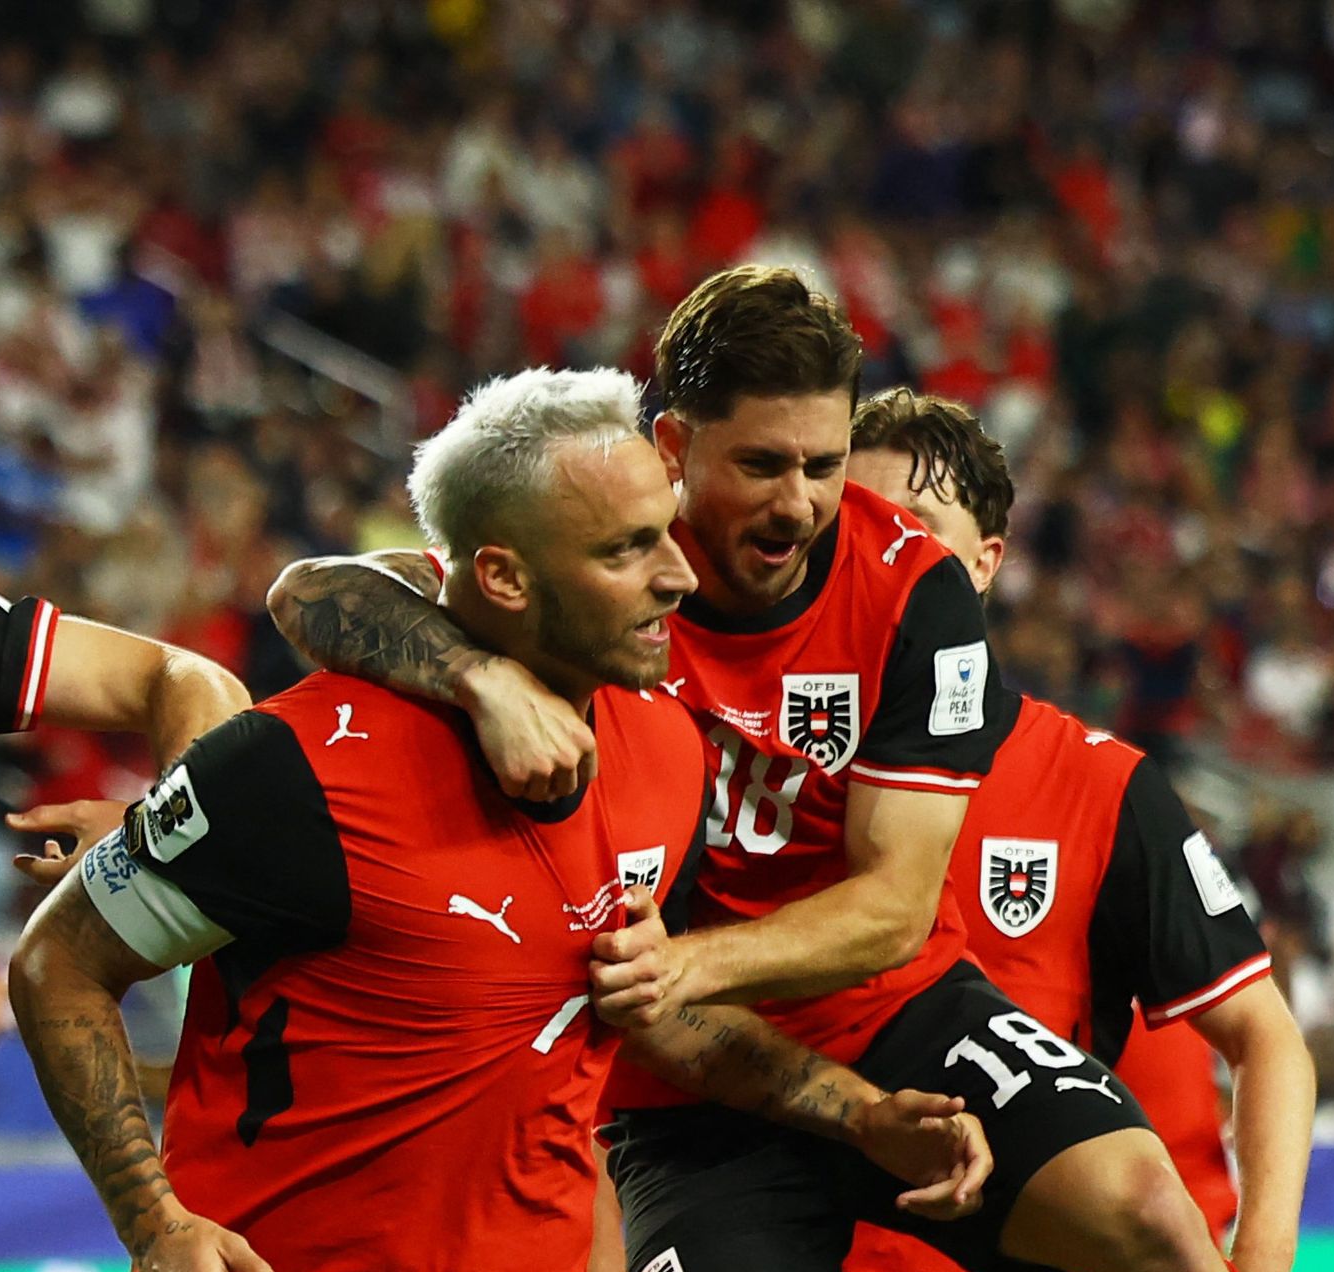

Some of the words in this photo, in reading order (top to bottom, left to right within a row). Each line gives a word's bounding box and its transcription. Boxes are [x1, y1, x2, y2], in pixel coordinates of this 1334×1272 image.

[802, 681, 835, 691] ÖFB
[705, 727, 809, 855] 18
[944, 1010, 1086, 1110] 18
